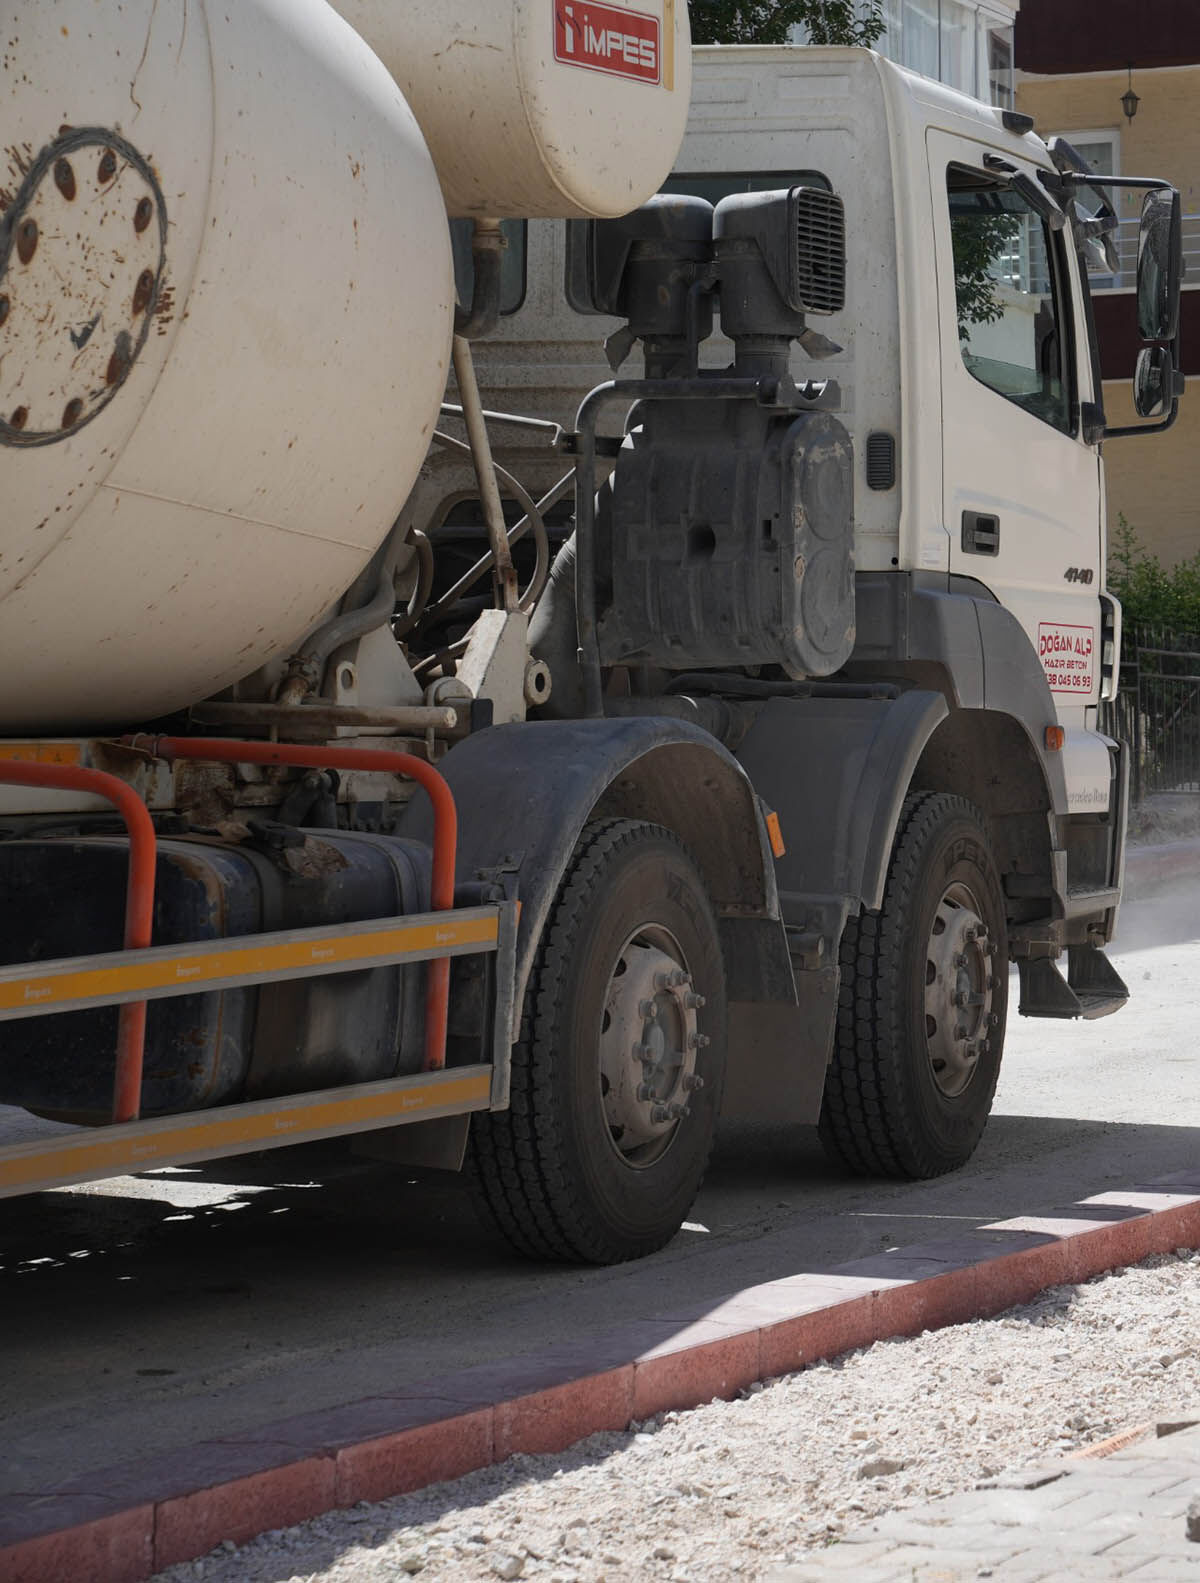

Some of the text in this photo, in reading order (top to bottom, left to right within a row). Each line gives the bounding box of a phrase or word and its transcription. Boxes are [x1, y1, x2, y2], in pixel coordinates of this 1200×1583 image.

[1064, 567, 1094, 584] 4140
[1074, 636, 1092, 657] ALP
[1066, 660, 1088, 670] BETON
[1045, 673, 1091, 687] 38 045 06 93
